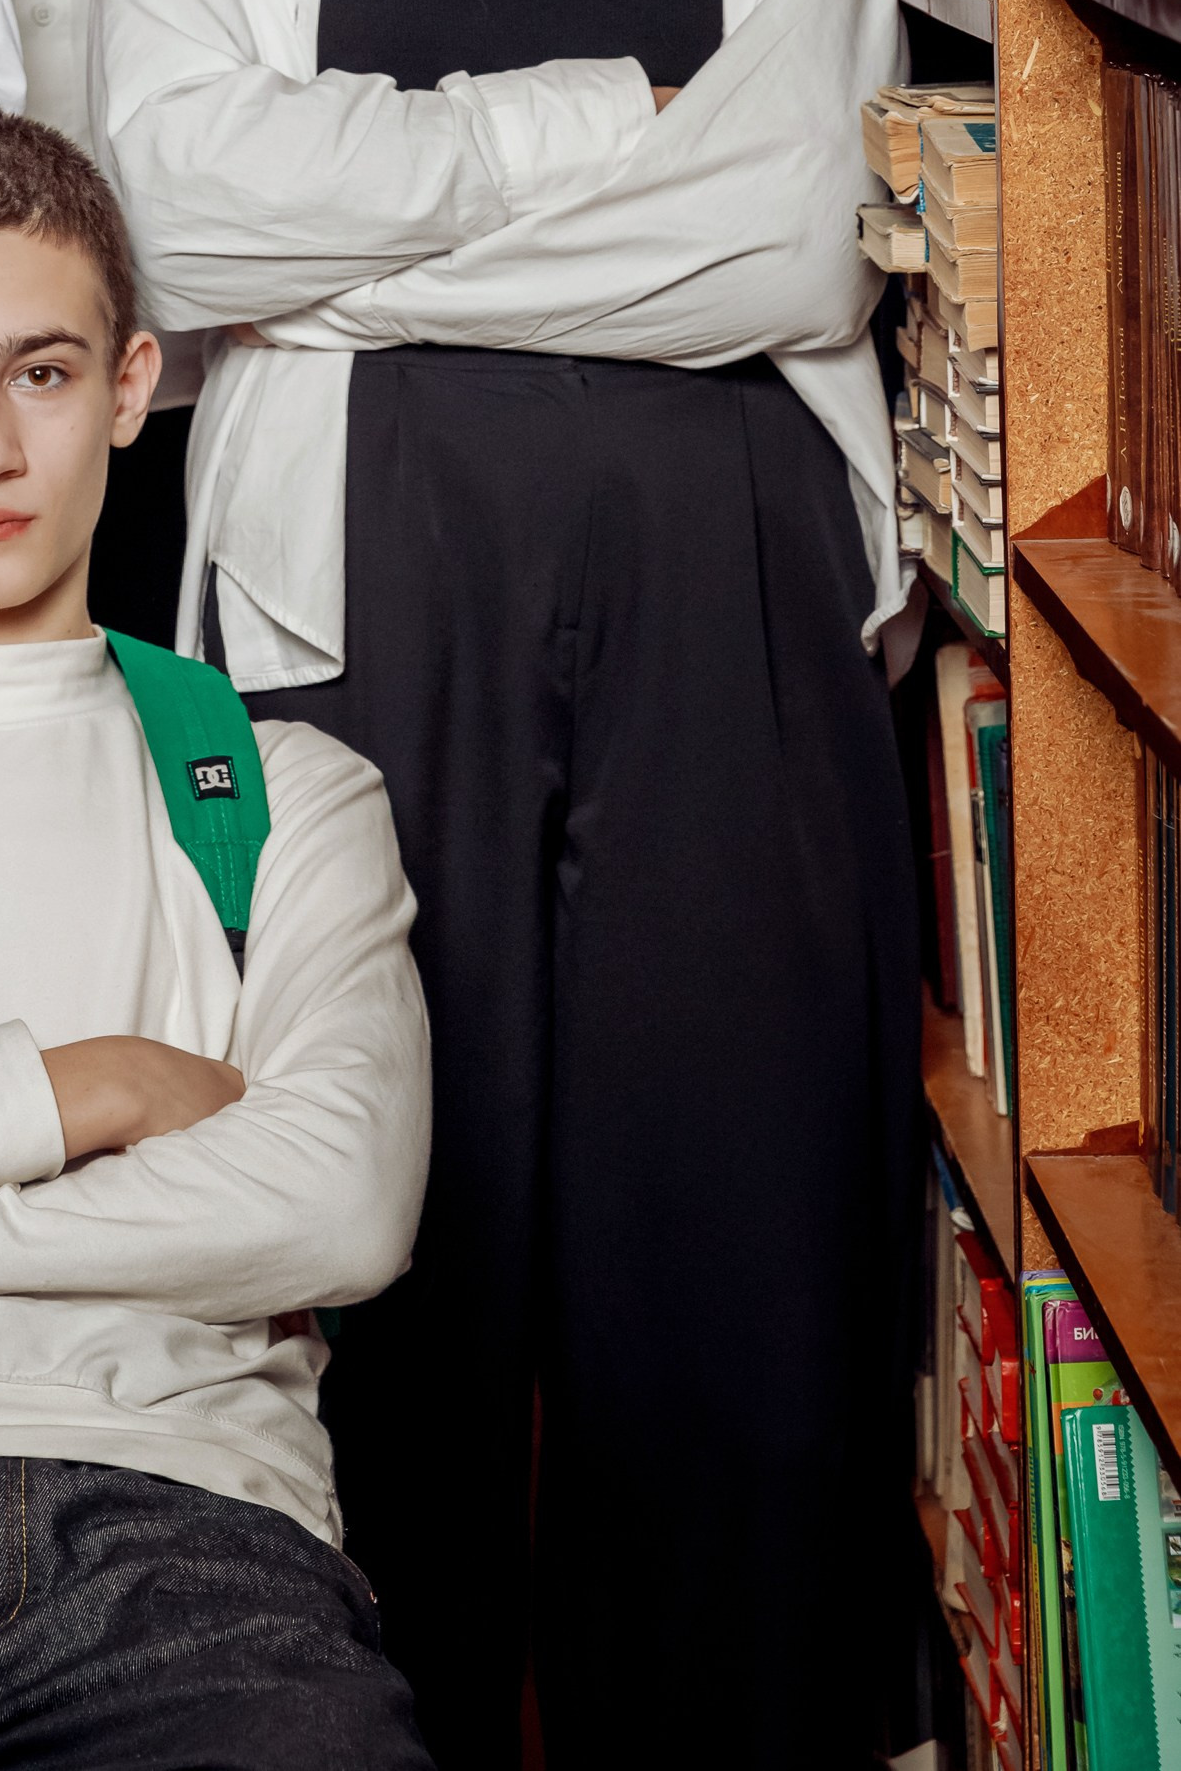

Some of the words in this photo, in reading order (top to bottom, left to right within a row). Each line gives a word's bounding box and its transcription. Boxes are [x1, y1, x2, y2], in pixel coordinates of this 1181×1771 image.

[1115, 151, 1123, 239] Каренина
[1116, 245, 1124, 294] Анна
[1118, 326, 1126, 404] Толстой
[1074, 1327, 1099, 1341] БИ
